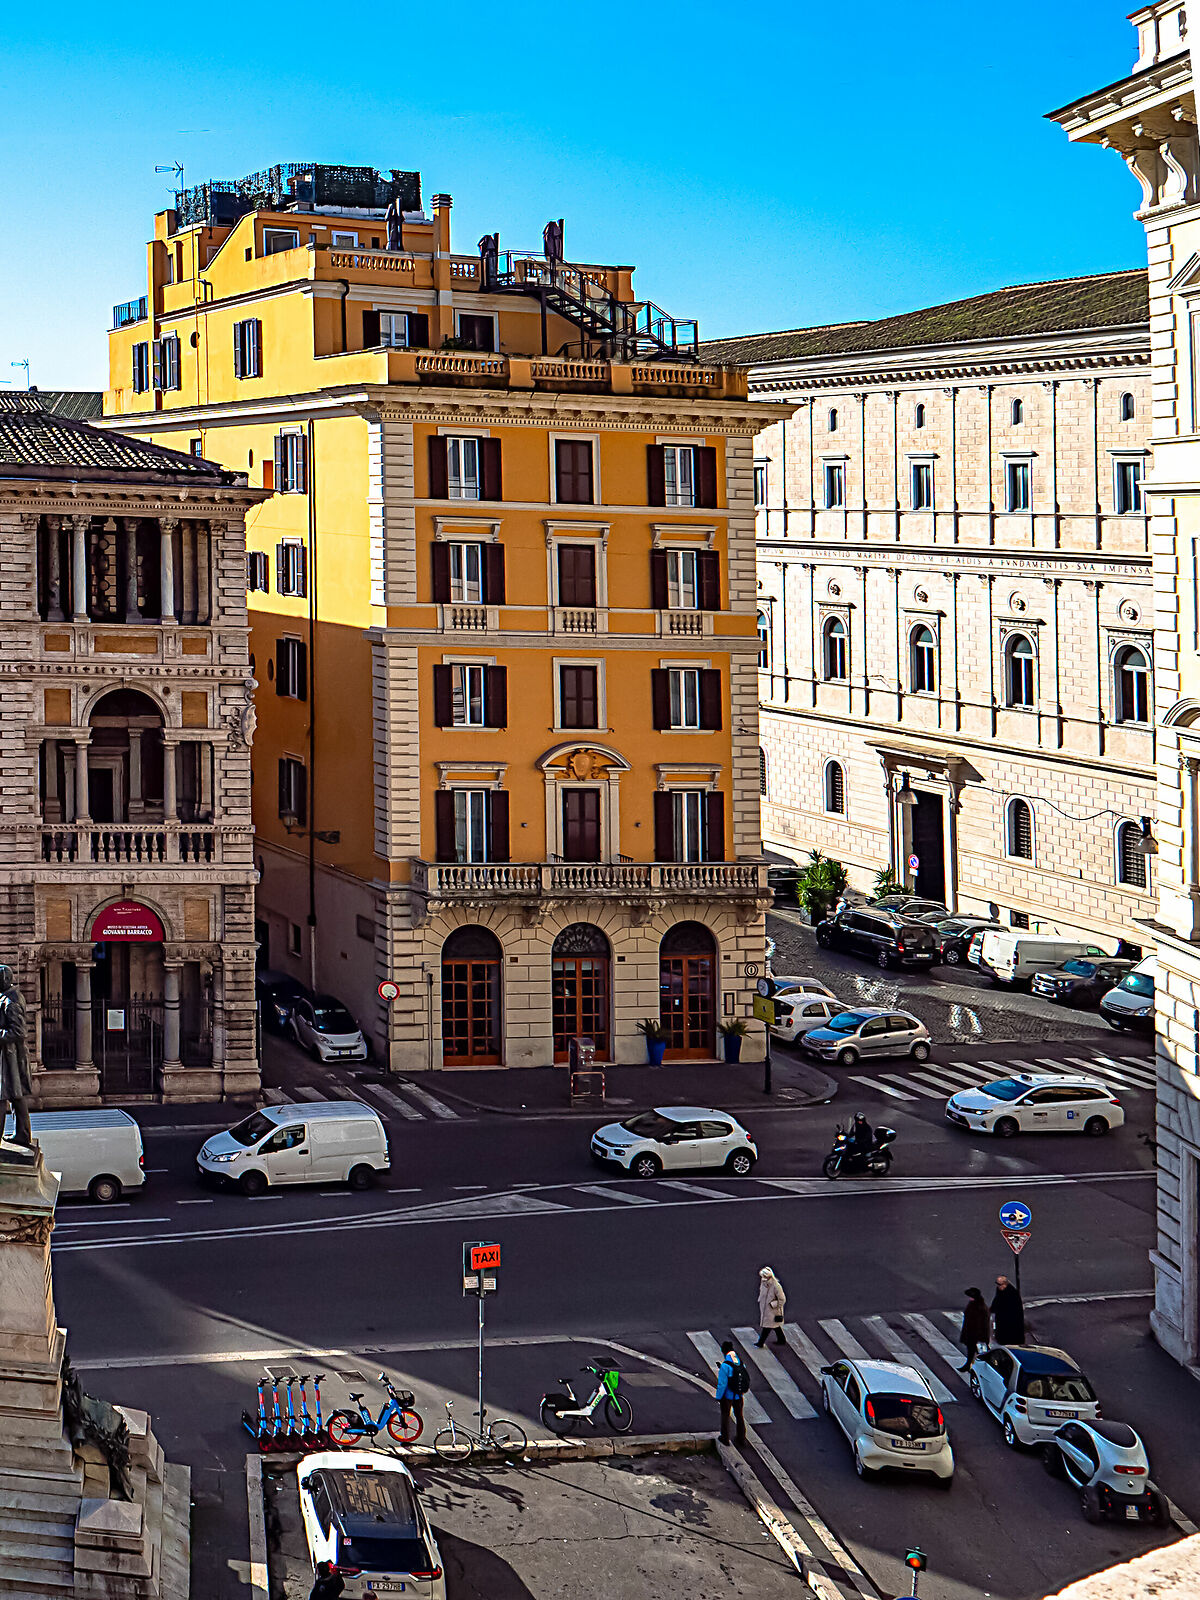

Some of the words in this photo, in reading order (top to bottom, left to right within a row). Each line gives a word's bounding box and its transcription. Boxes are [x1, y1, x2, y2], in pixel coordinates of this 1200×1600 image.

[1000, 560, 1069, 570] FVNDAMENTIS
[1077, 563, 1096, 571] SVA
[1103, 565, 1151, 575] IMPENSA
[474, 1250, 499, 1264] TAXI
